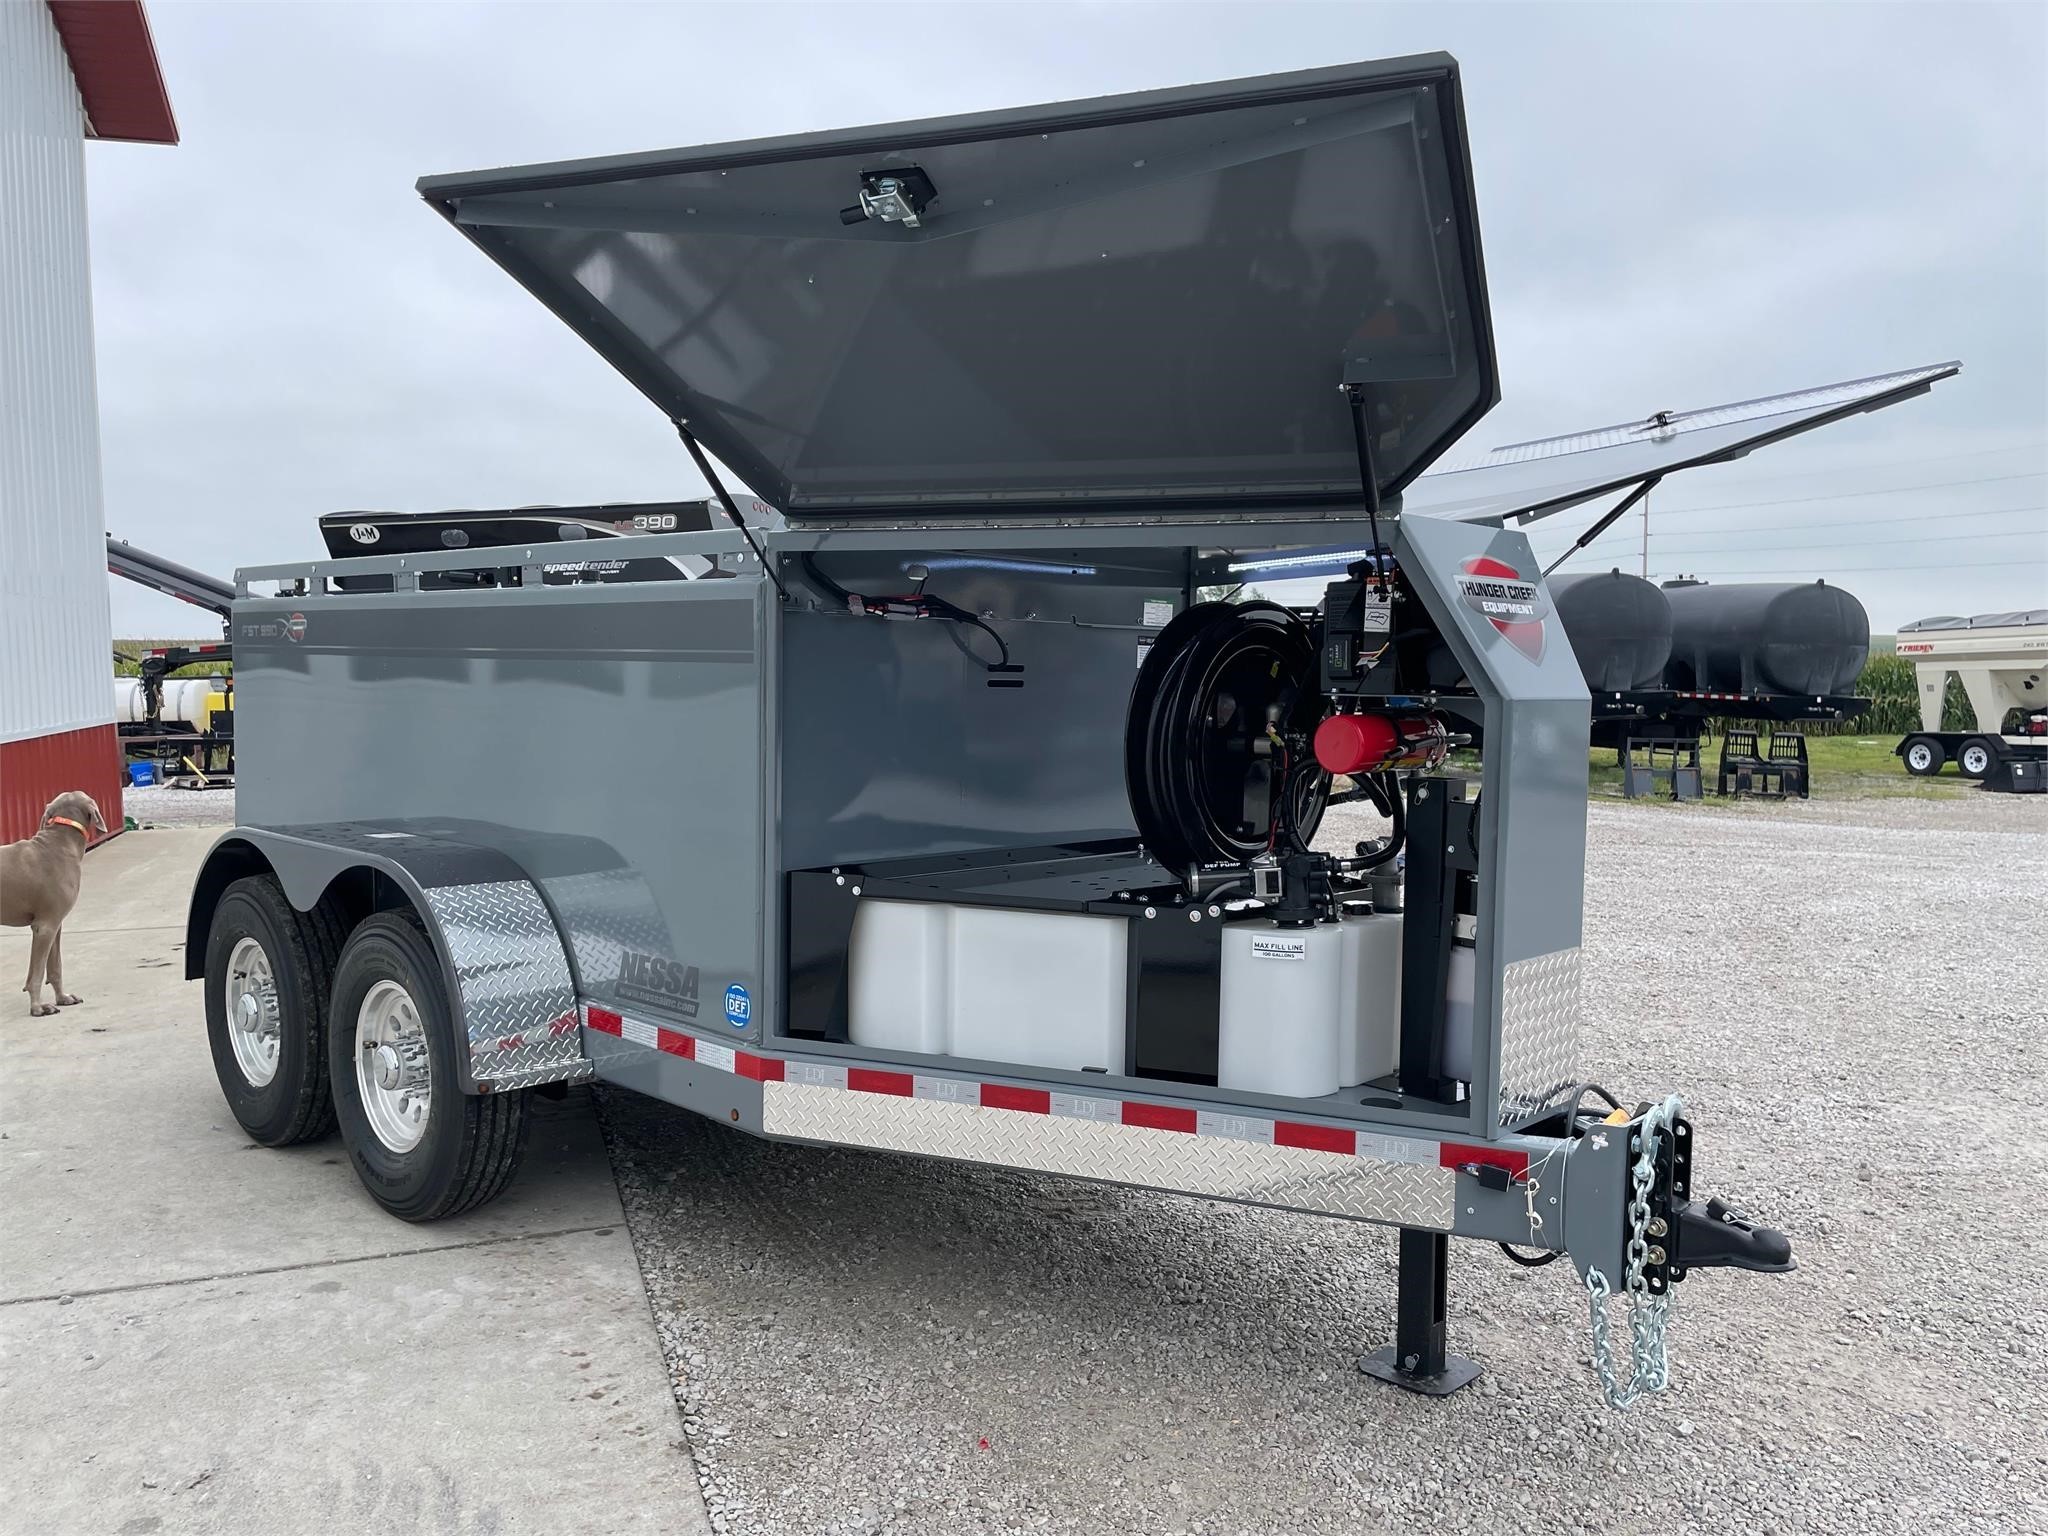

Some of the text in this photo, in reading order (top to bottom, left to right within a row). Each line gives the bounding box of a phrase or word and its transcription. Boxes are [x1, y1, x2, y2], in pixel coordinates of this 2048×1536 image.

[543, 560, 629, 574] speedtender
[1458, 580, 1537, 601] THUNDER CREEK
[1482, 601, 1534, 615] EQUIPMENT
[1270, 943, 1286, 951] FILL
[620, 950, 700, 1000] NESSA
[728, 998, 747, 1014] DEF
